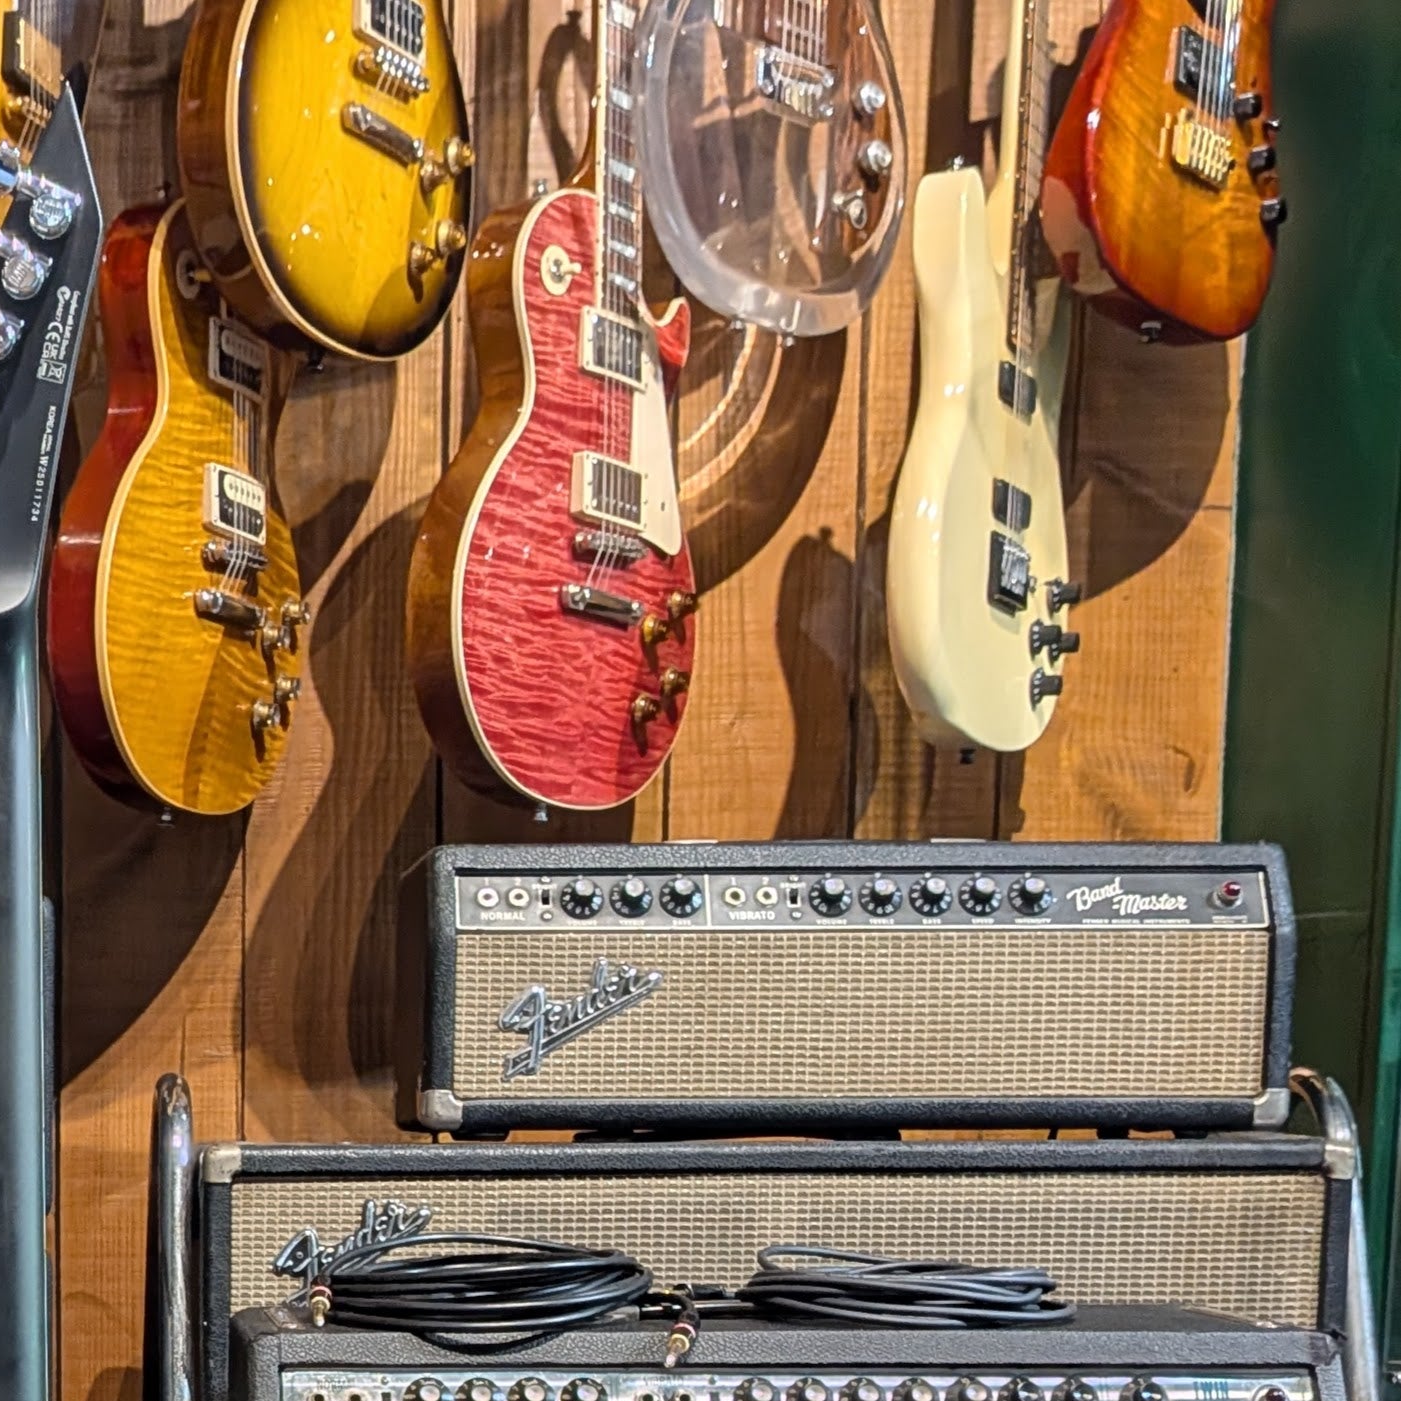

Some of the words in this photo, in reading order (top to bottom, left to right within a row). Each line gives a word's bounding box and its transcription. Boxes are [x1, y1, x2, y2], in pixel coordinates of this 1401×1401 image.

[45, 405, 57, 434] KOREA
[1066, 876, 1124, 912] Band
[481, 911, 526, 921] NORMAL
[728, 911, 776, 921] VIBRATO
[500, 956, 663, 1082] Fender
